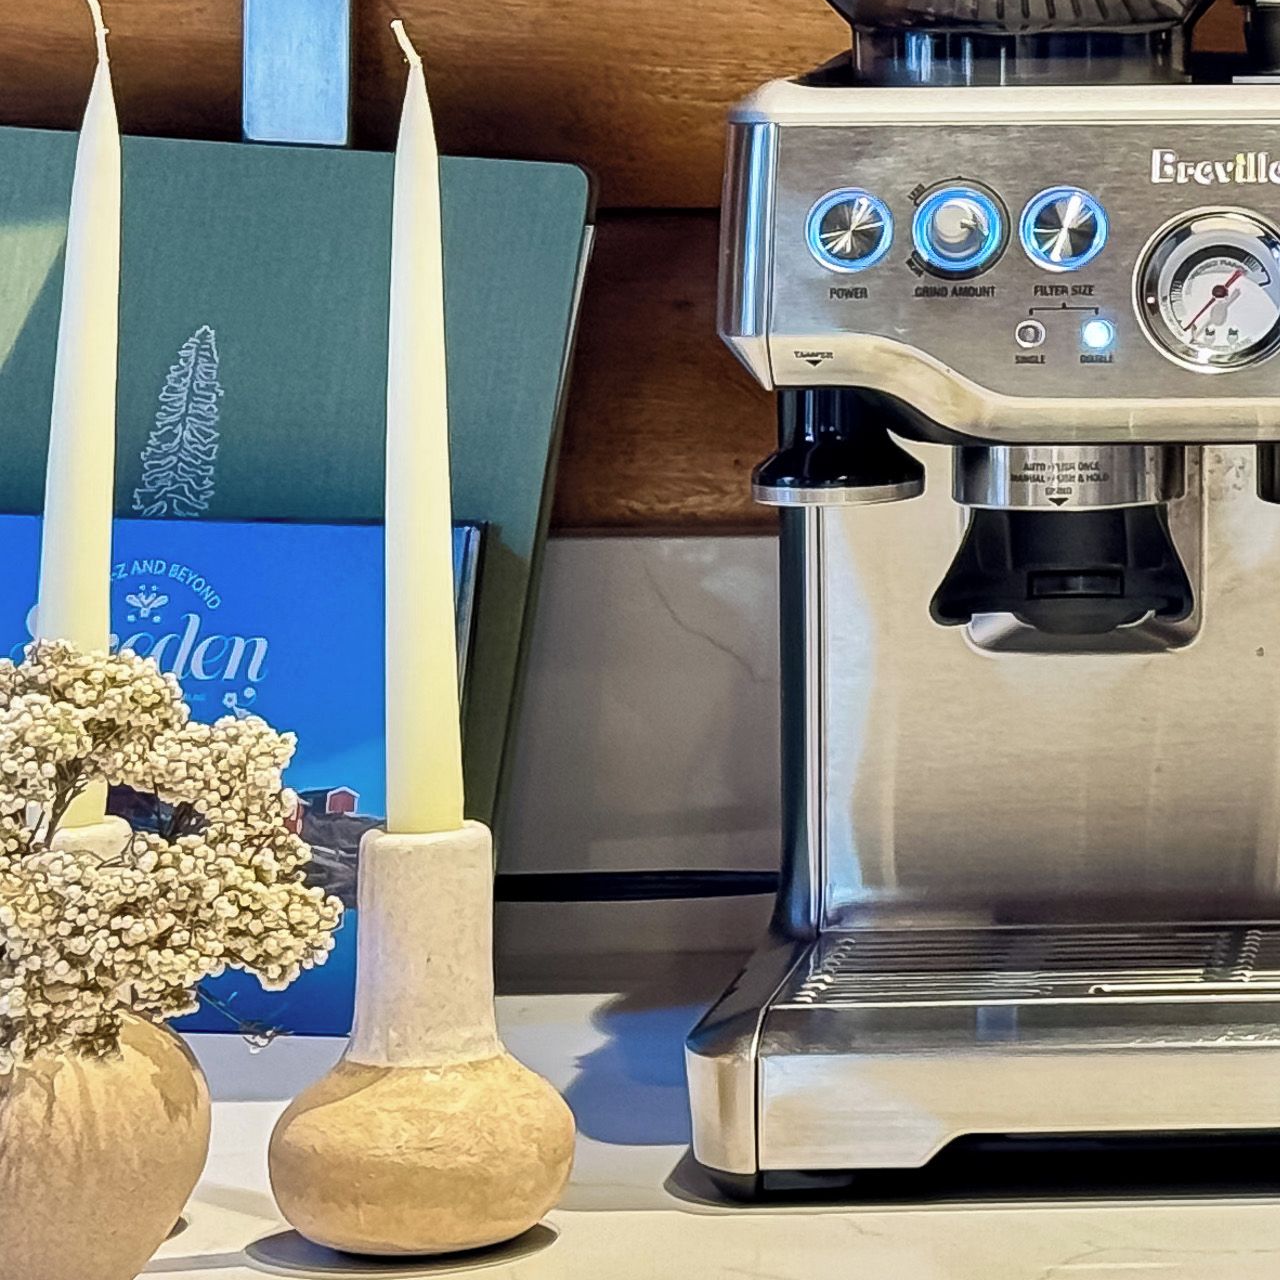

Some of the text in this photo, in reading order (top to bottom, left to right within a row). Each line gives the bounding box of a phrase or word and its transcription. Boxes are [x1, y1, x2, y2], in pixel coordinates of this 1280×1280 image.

[829, 287, 868, 299] POWER
[914, 286, 996, 298] GRIND AMOUNT
[1034, 285, 1095, 296] FILTER SIZE
[1022, 462, 1046, 471] AUTO
[1078, 461, 1101, 471] ONCE
[1086, 472, 1110, 483] HOLD
[131, 559, 167, 576] AND
[168, 562, 223, 611] BEYOND
